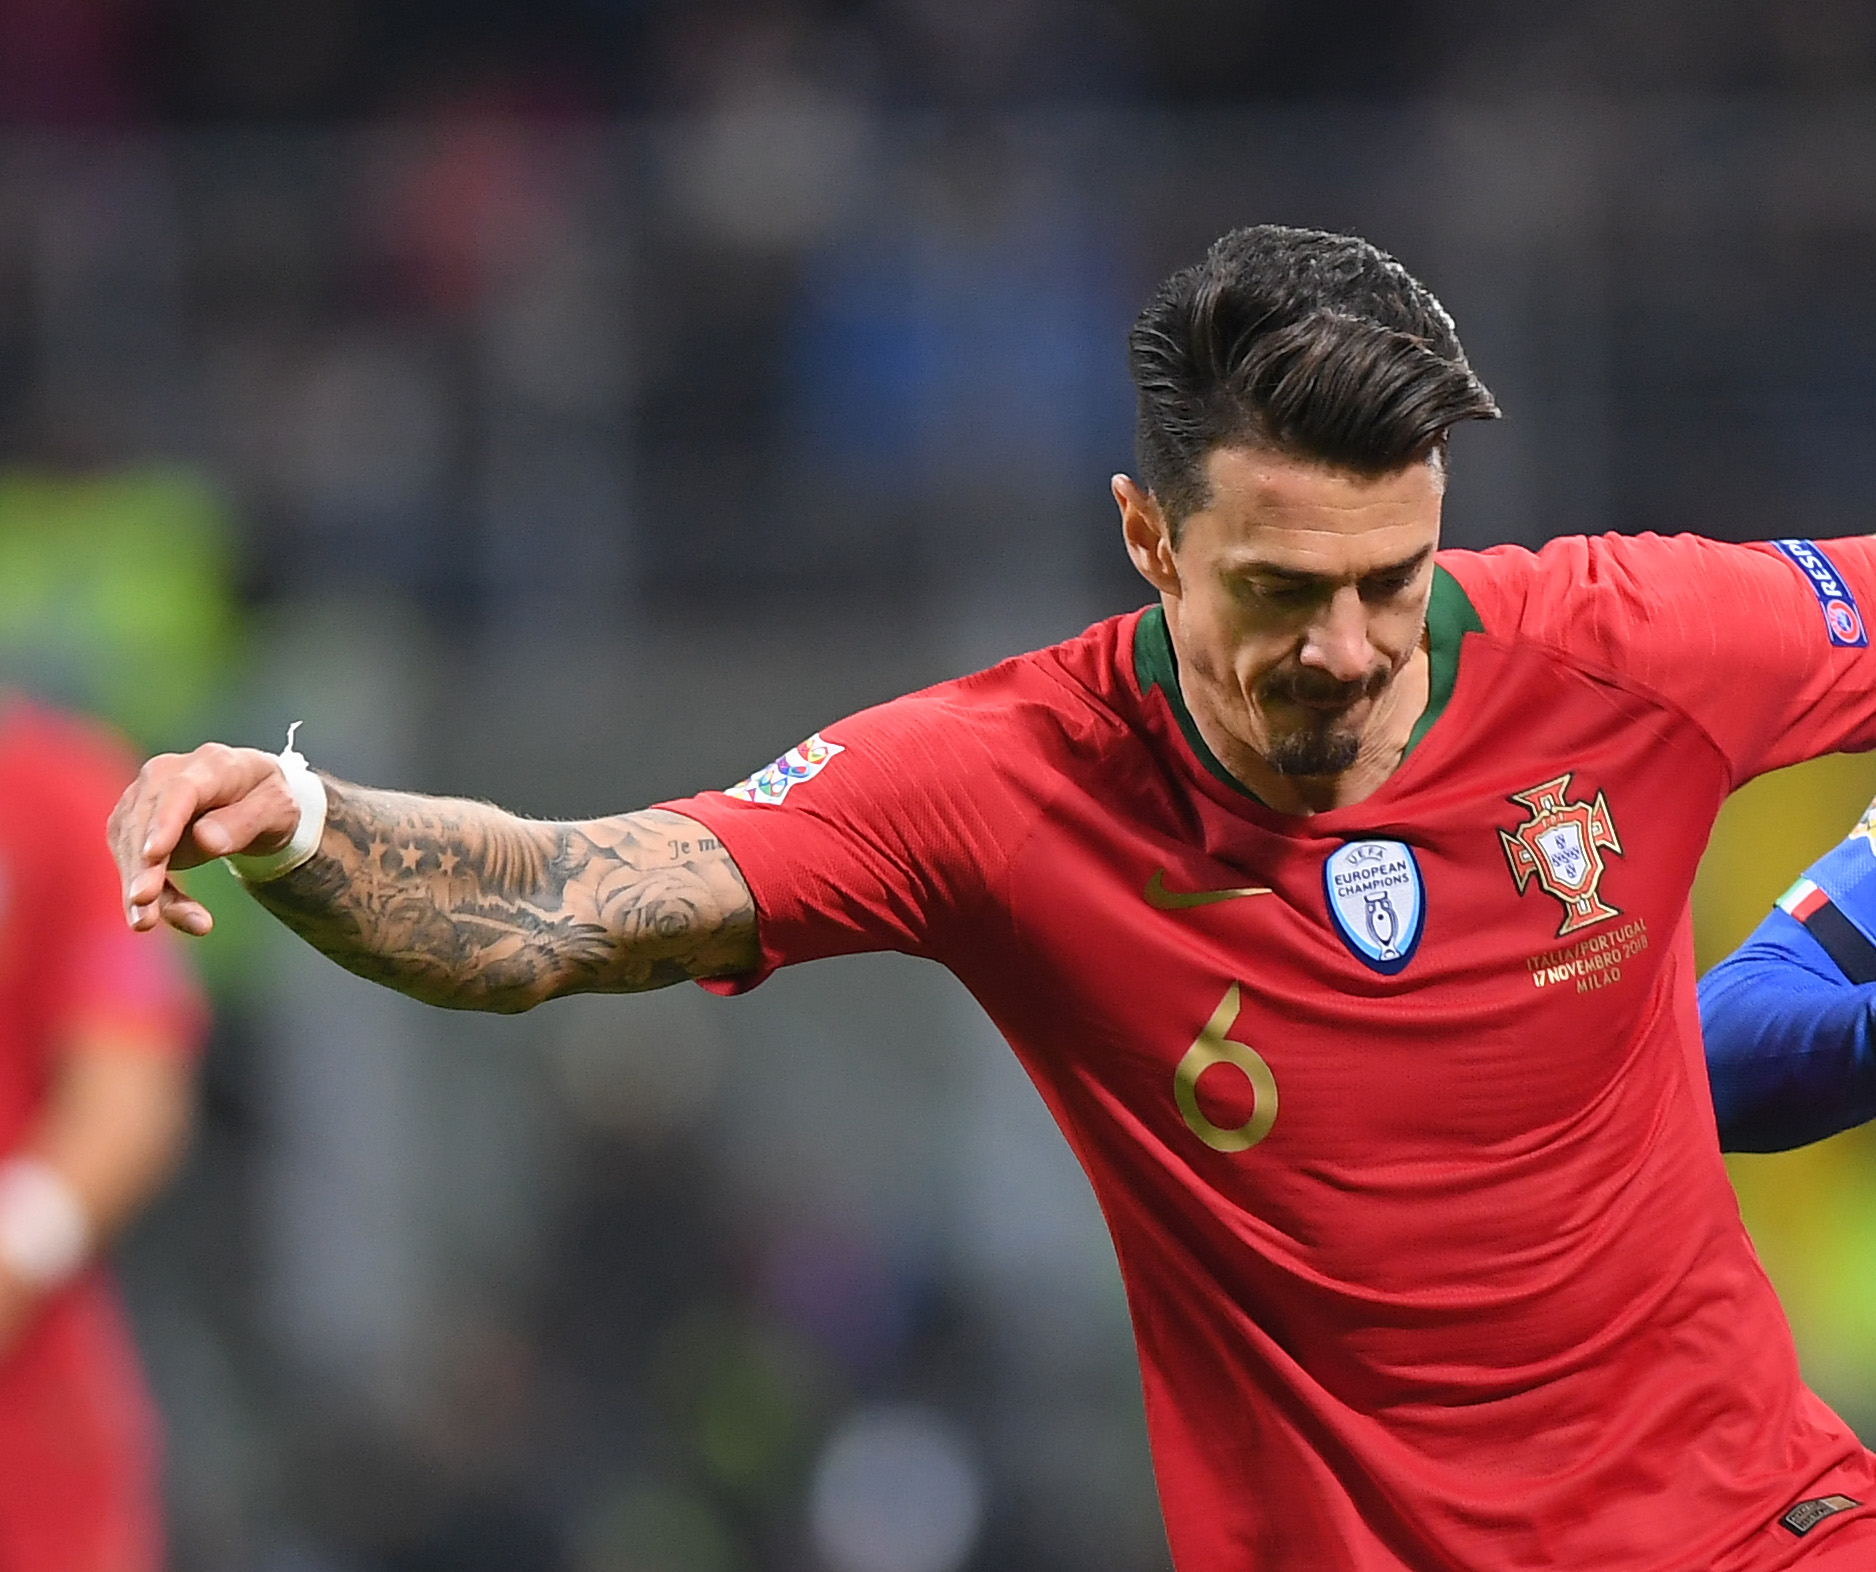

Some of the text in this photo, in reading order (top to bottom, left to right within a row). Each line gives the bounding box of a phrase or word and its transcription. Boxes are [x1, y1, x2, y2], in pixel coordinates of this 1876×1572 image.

[1780, 540, 1843, 597] RESP
[1334, 860, 1407, 886] EUROPEAN
[1348, 847, 1383, 864] UEFA
[1337, 873, 1410, 897] CHAMPIONS
[1533, 934, 1649, 988] 17 NOVEMBRO 2018
[1174, 979, 1279, 1153] 6
